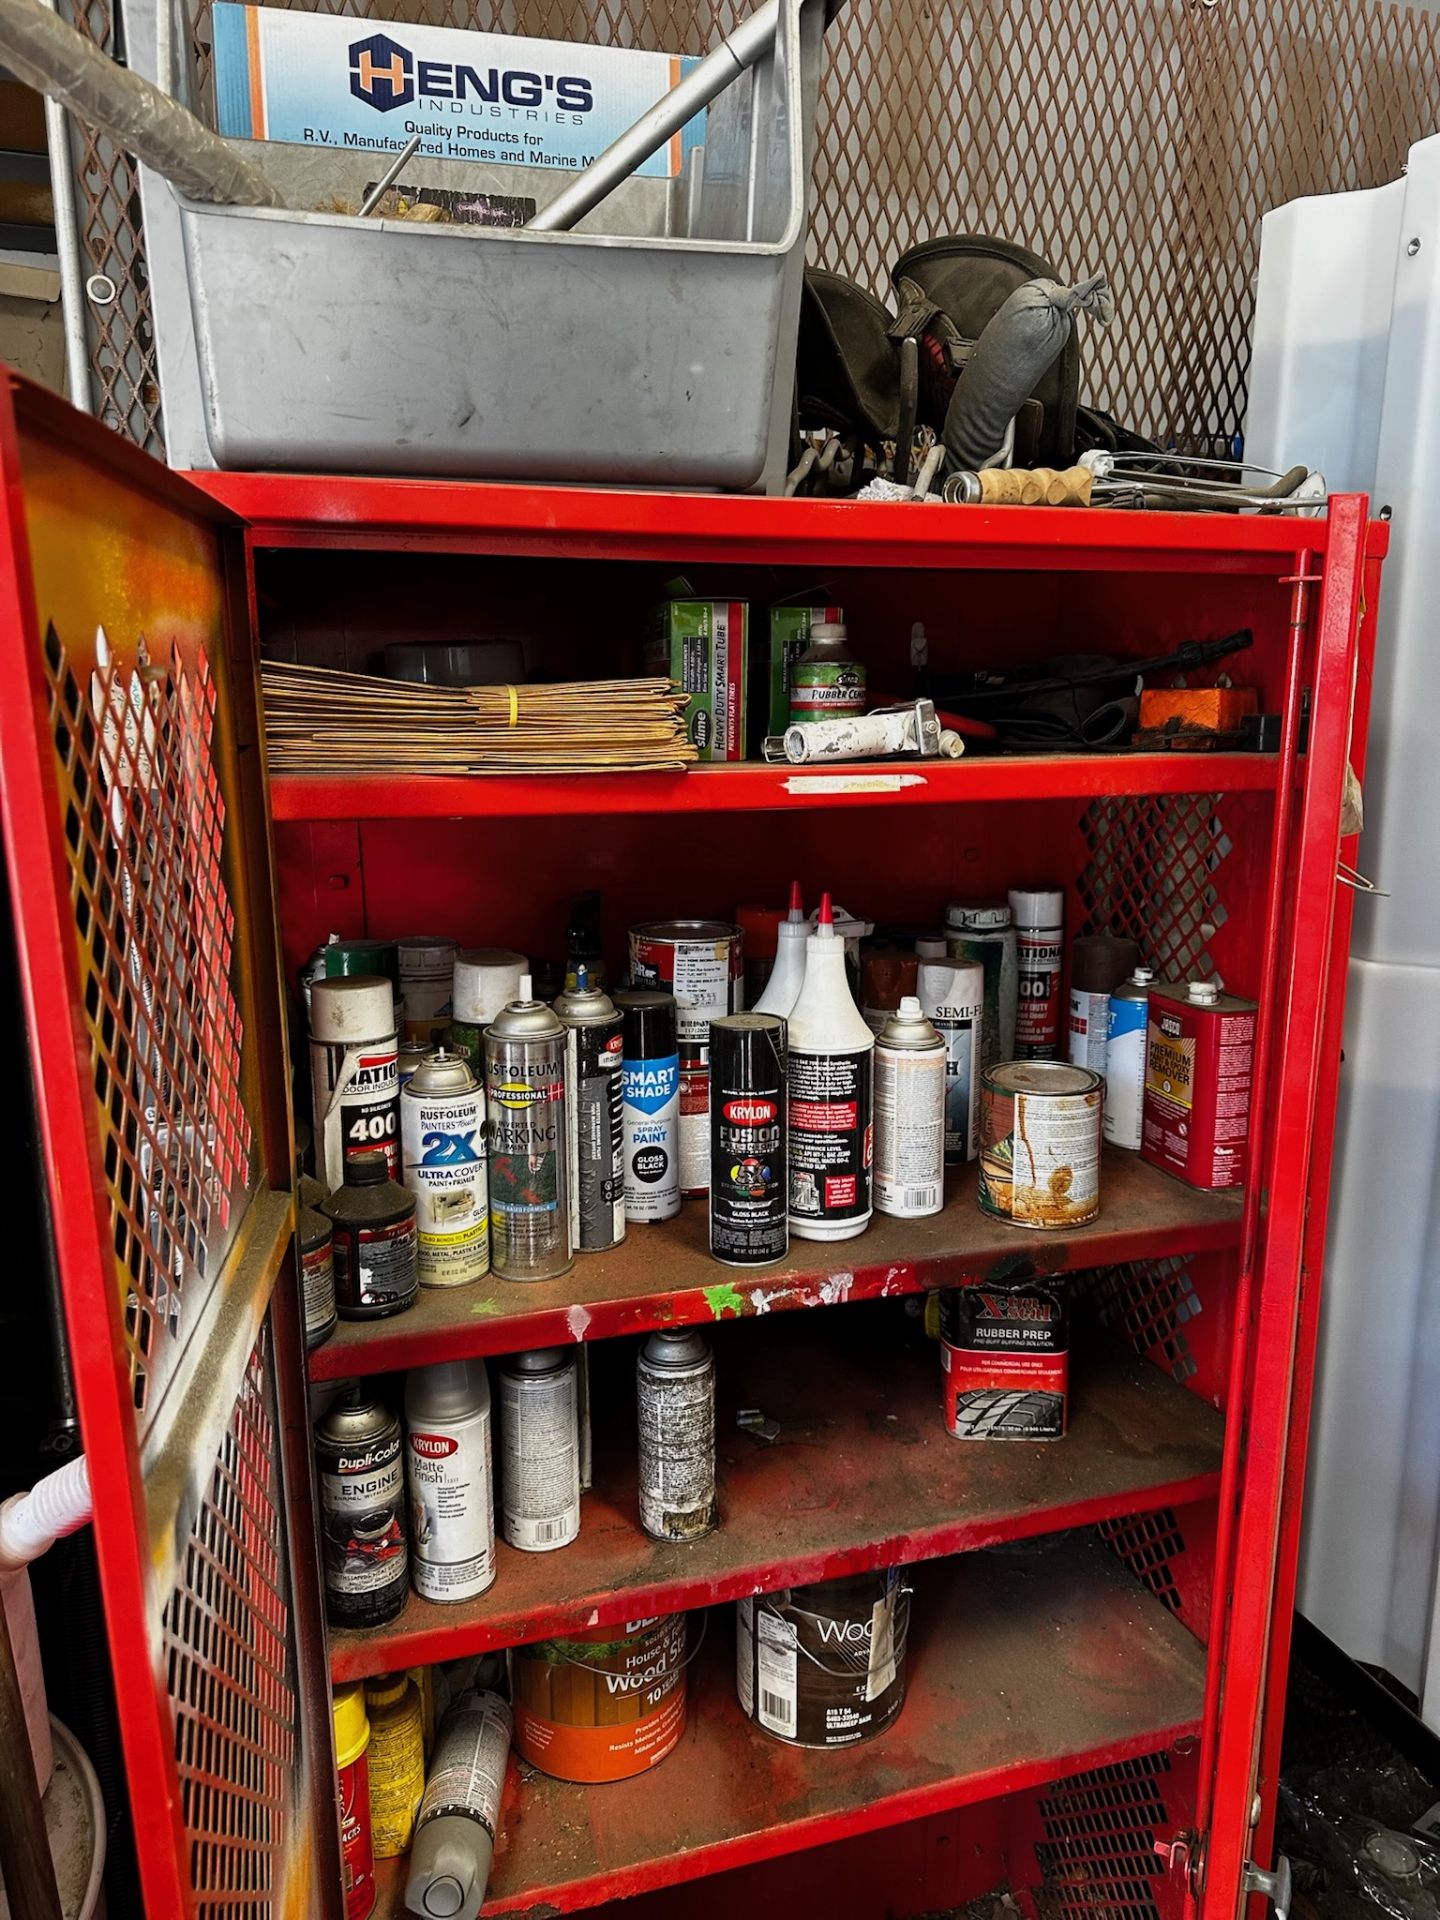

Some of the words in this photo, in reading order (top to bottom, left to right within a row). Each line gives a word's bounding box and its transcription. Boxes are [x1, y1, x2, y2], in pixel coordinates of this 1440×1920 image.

[419, 98, 583, 126] INDUSTRIES
[404, 120, 452, 140] Quality
[457, 125, 519, 144] Products
[524, 132, 543, 146] for
[303, 127, 338, 146] R.V.,
[344, 131, 443, 155] Manufacred
[449, 143, 496, 160] Homes
[500, 149, 525, 163] and
[530, 151, 577, 168] Marine
[715, 624, 726, 651] TUBE
[715, 653, 725, 688] SMART
[714, 689, 725, 717] DUTY
[694, 711, 707, 748] slime
[714, 720, 725, 751] HEAVY
[1150, 1041, 1191, 1067] PREMIUM
[489, 1061, 559, 1077] UST-OLEUM
[622, 1066, 675, 1086] SMART
[1150, 1059, 1190, 1086] REMOVER
[490, 1088, 548, 1100] PROFESSIONAL
[626, 1083, 671, 1098] SHADE
[729, 1104, 771, 1120] KRYLON
[349, 1112, 397, 1142] 400
[637, 1125, 663, 1133] SPRAY
[421, 1129, 479, 1165] 2X
[632, 1131, 668, 1144] PAINT
[637, 1154, 665, 1164] GLOSS
[637, 1162, 665, 1170] BLACK
[417, 1169, 453, 1180] ULTRA
[454, 1162, 483, 1178] COVER
[731, 1210, 750, 1218] GLOSS
[750, 1210, 769, 1218] BLACK
[975, 1327, 1020, 1339] RUBBER
[1022, 1329, 1051, 1340] PREP
[412, 1435, 450, 1453] KRYLON
[338, 1439, 400, 1470] Dupli-Color
[413, 1456, 444, 1473] Matte
[341, 1468, 398, 1496] ENGINE
[414, 1467, 443, 1484] Finish
[625, 1646, 661, 1669] House
[662, 1634, 671, 1649] &
[605, 1653, 667, 1694] Wood
[646, 1687, 662, 1705] 10
[608, 1740, 634, 1752] Resists
